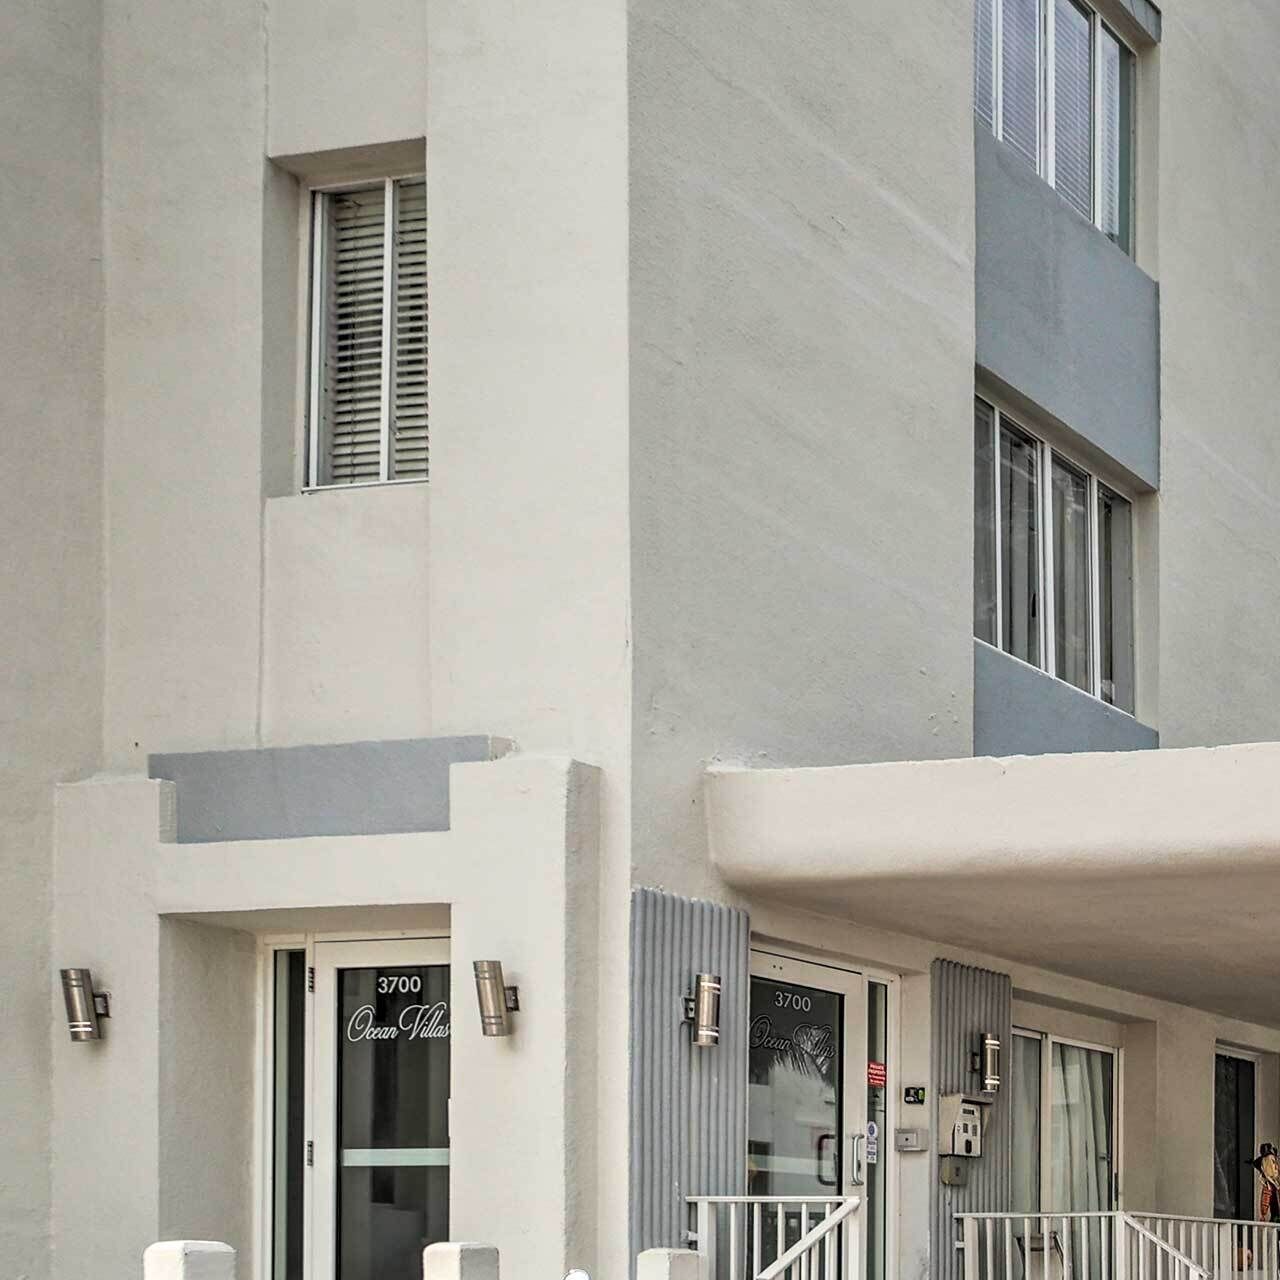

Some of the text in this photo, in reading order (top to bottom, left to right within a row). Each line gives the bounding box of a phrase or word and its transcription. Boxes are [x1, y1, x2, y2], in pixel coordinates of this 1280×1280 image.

[378, 976, 421, 993] 3700
[775, 991, 811, 1012] 3700
[347, 1001, 450, 1042] Ocean Villas
[750, 1014, 835, 1058] Ocean Villas
